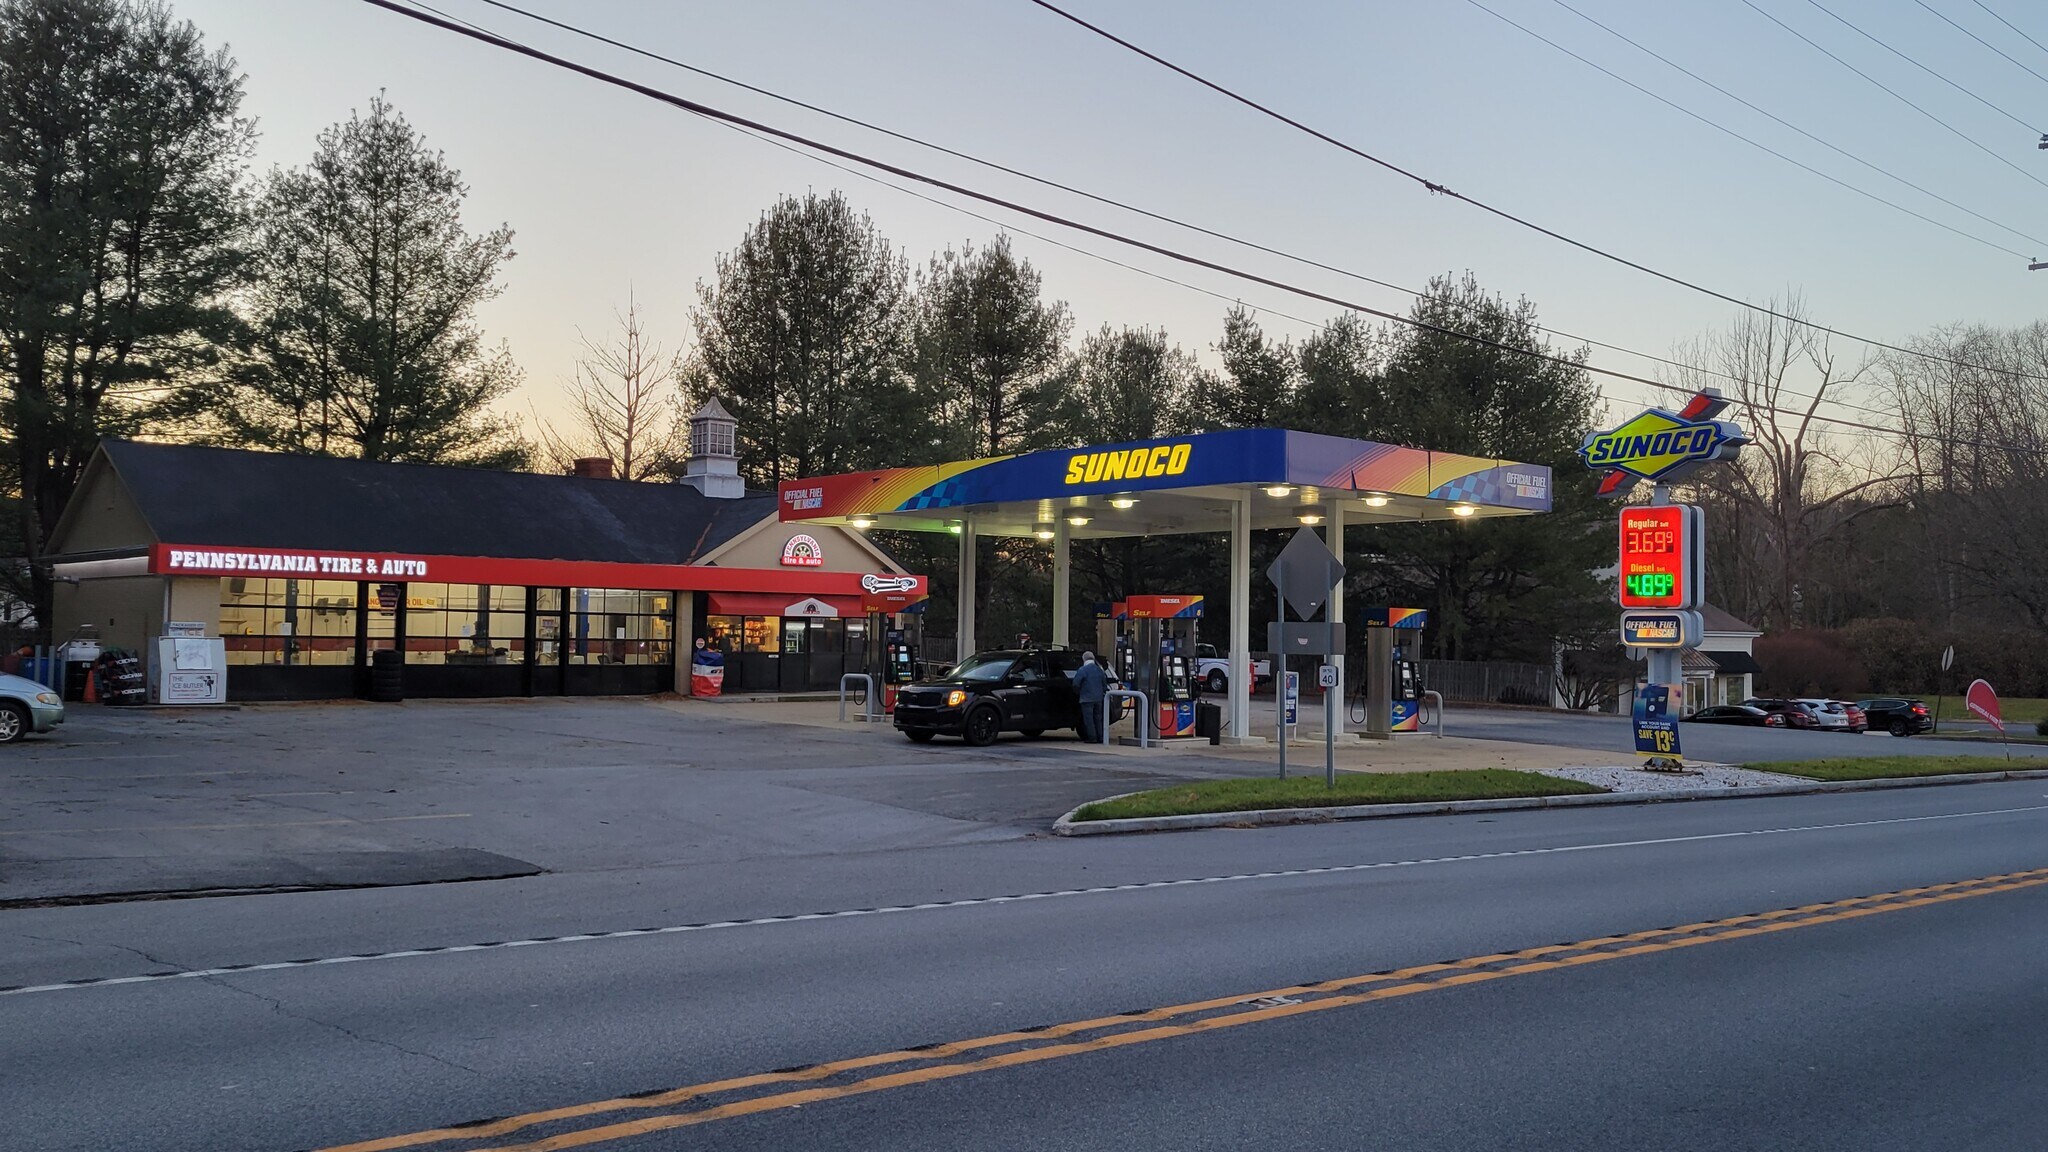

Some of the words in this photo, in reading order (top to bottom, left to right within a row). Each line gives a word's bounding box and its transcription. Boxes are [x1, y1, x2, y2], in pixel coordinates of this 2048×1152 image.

[1592, 429, 1712, 461] SUNOCO
[1065, 444, 1192, 484] SUNOCO
[1506, 472, 1532, 486] OFFICIAL
[1532, 475, 1547, 488] FUEL
[784, 489, 808, 501] OFFICIAL
[809, 487, 823, 498] FUEL
[801, 498, 823, 509] NASCAR
[1627, 519, 1658, 530] Regular
[785, 535, 820, 557] PENNSYLVANIA
[169, 550, 318, 572] PENNSYLVANIA
[319, 556, 363, 574] TIRE
[365, 558, 379, 574] &
[381, 559, 427, 576] AUTO
[798, 557, 804, 565] &
[1630, 563, 1654, 573] Diesel
[412, 598, 423, 606] OIL
[1626, 620, 1658, 630] OFFICIAL
[1659, 620, 1677, 629] FUEL
[1649, 628, 1676, 638] NASCAR
[1322, 674, 1333, 685] 40
[1638, 729, 1653, 739] SAVE
